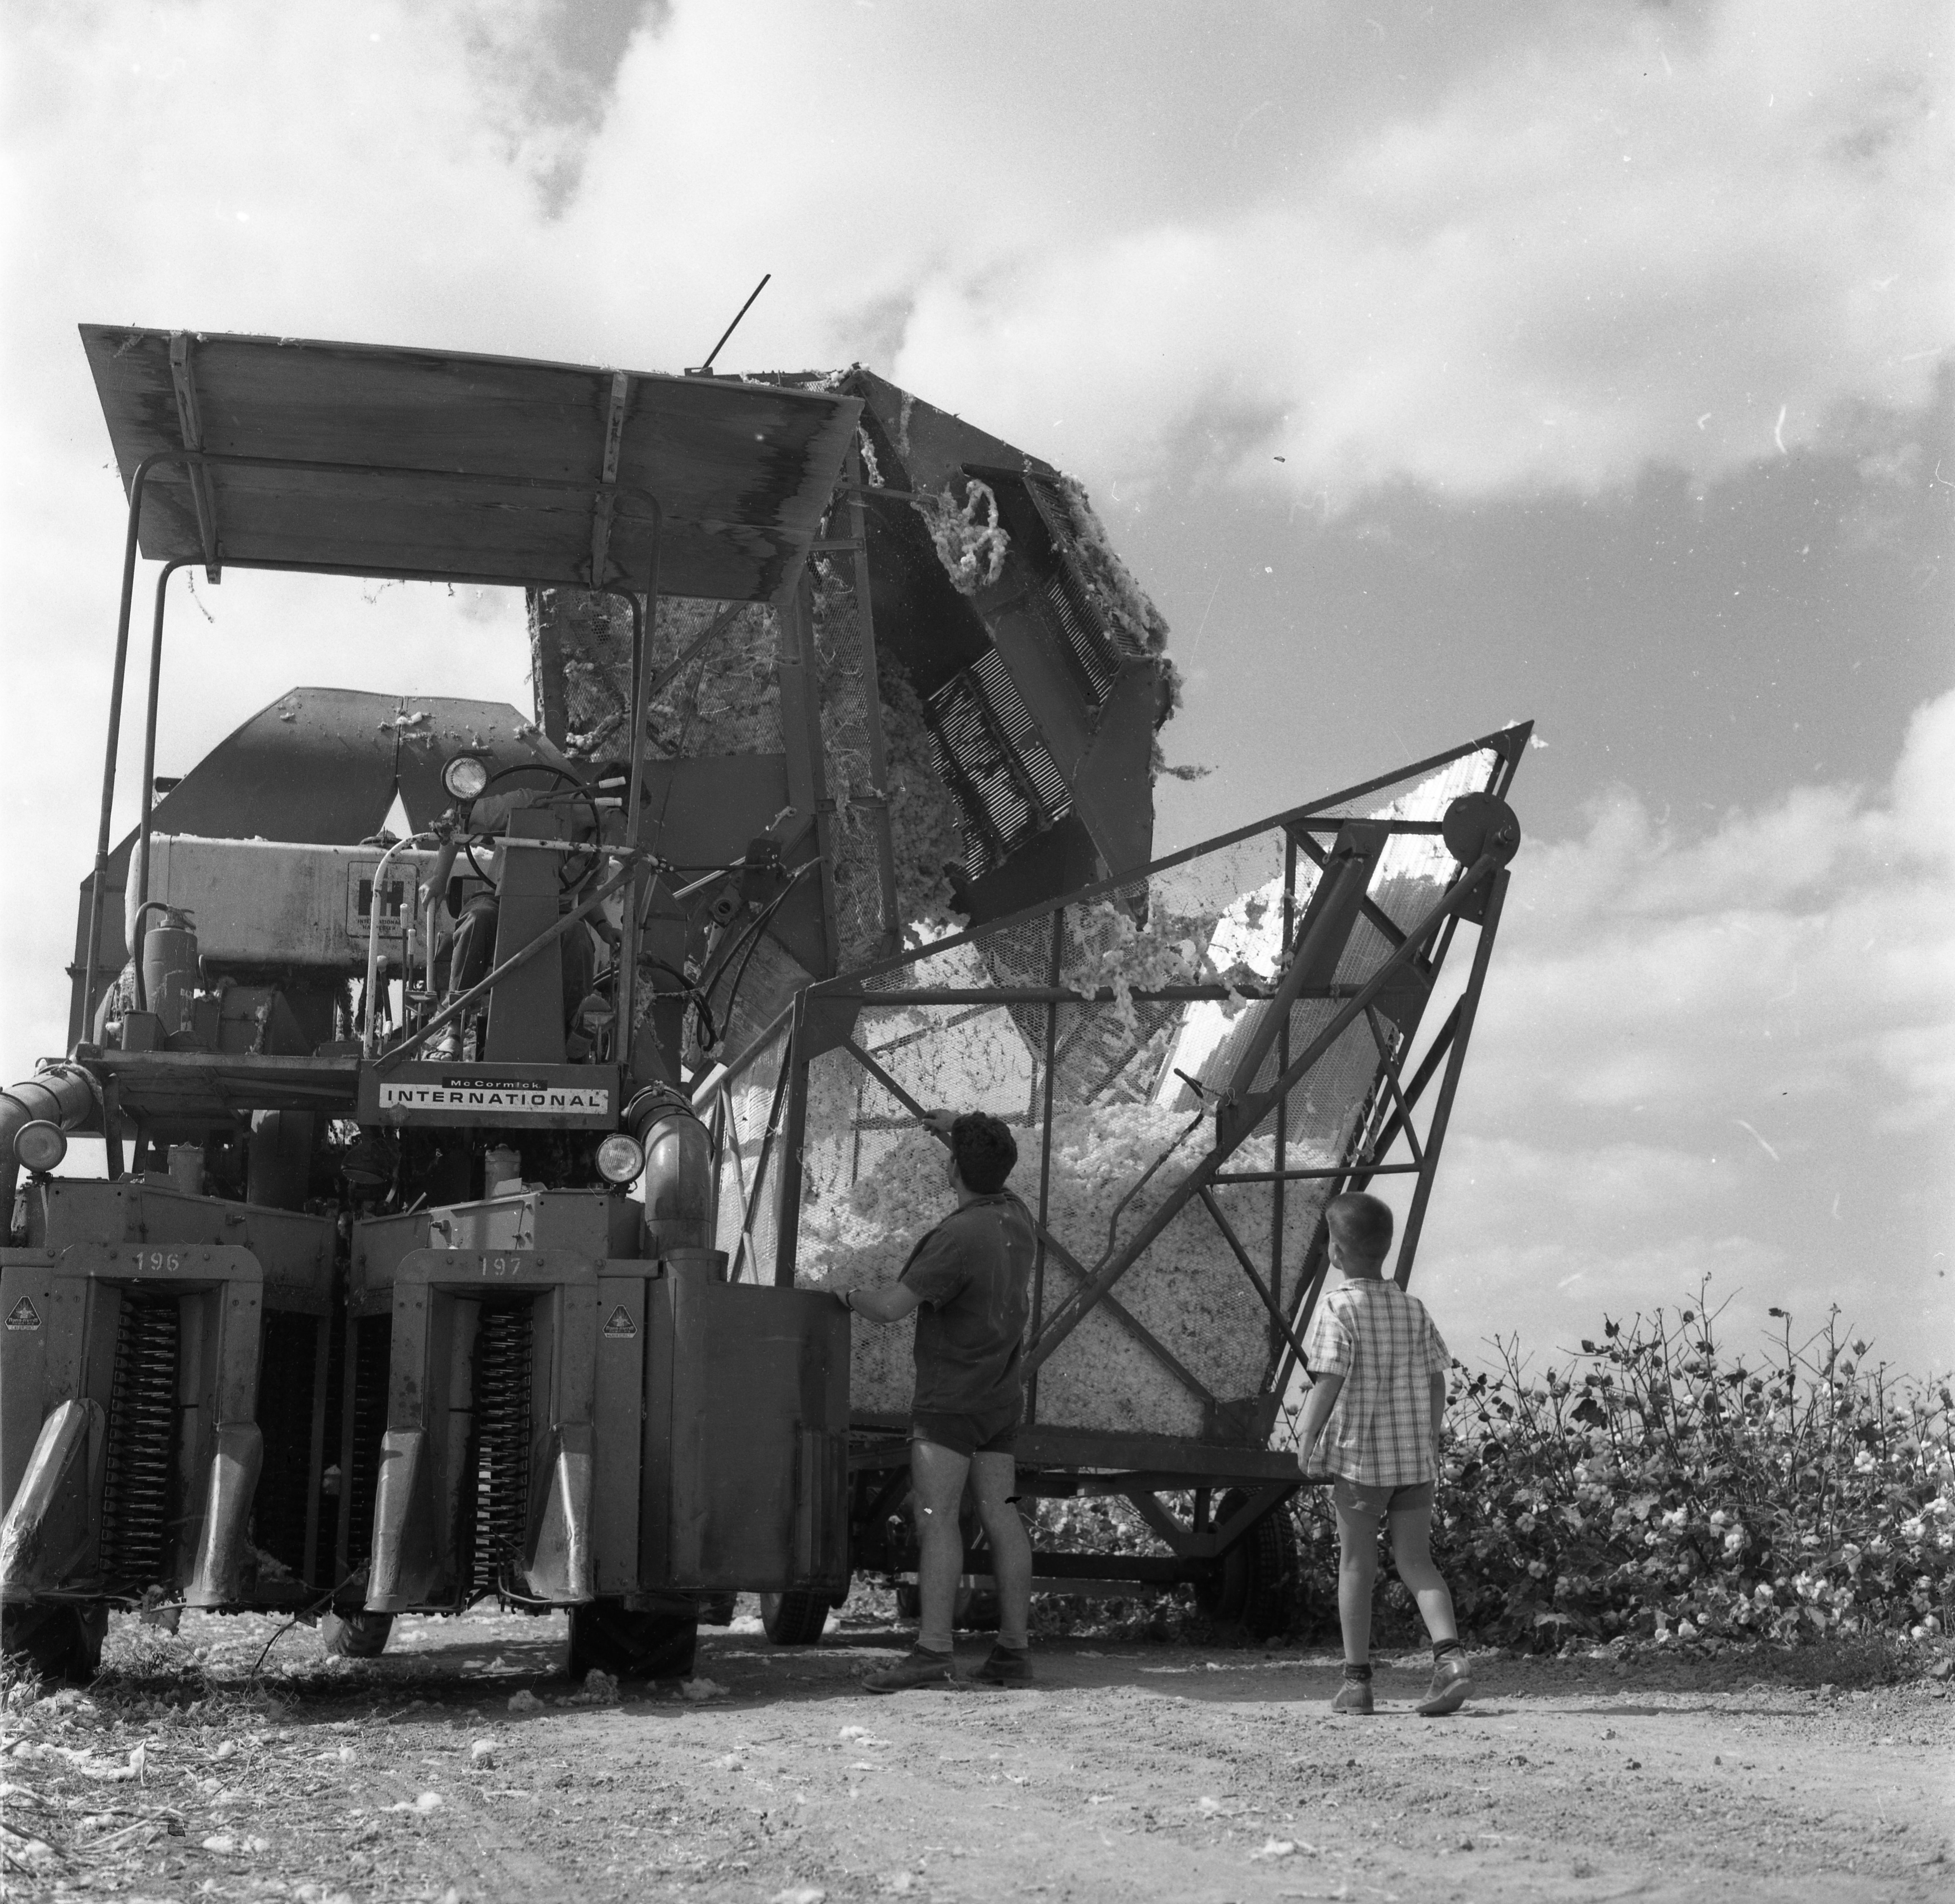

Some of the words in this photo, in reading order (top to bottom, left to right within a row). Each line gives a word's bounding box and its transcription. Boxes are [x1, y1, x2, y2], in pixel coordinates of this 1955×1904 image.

[388, 1090, 601, 1107] INTERNATIONAL
[136, 1252, 179, 1271] 196
[482, 1257, 521, 1276] 197
